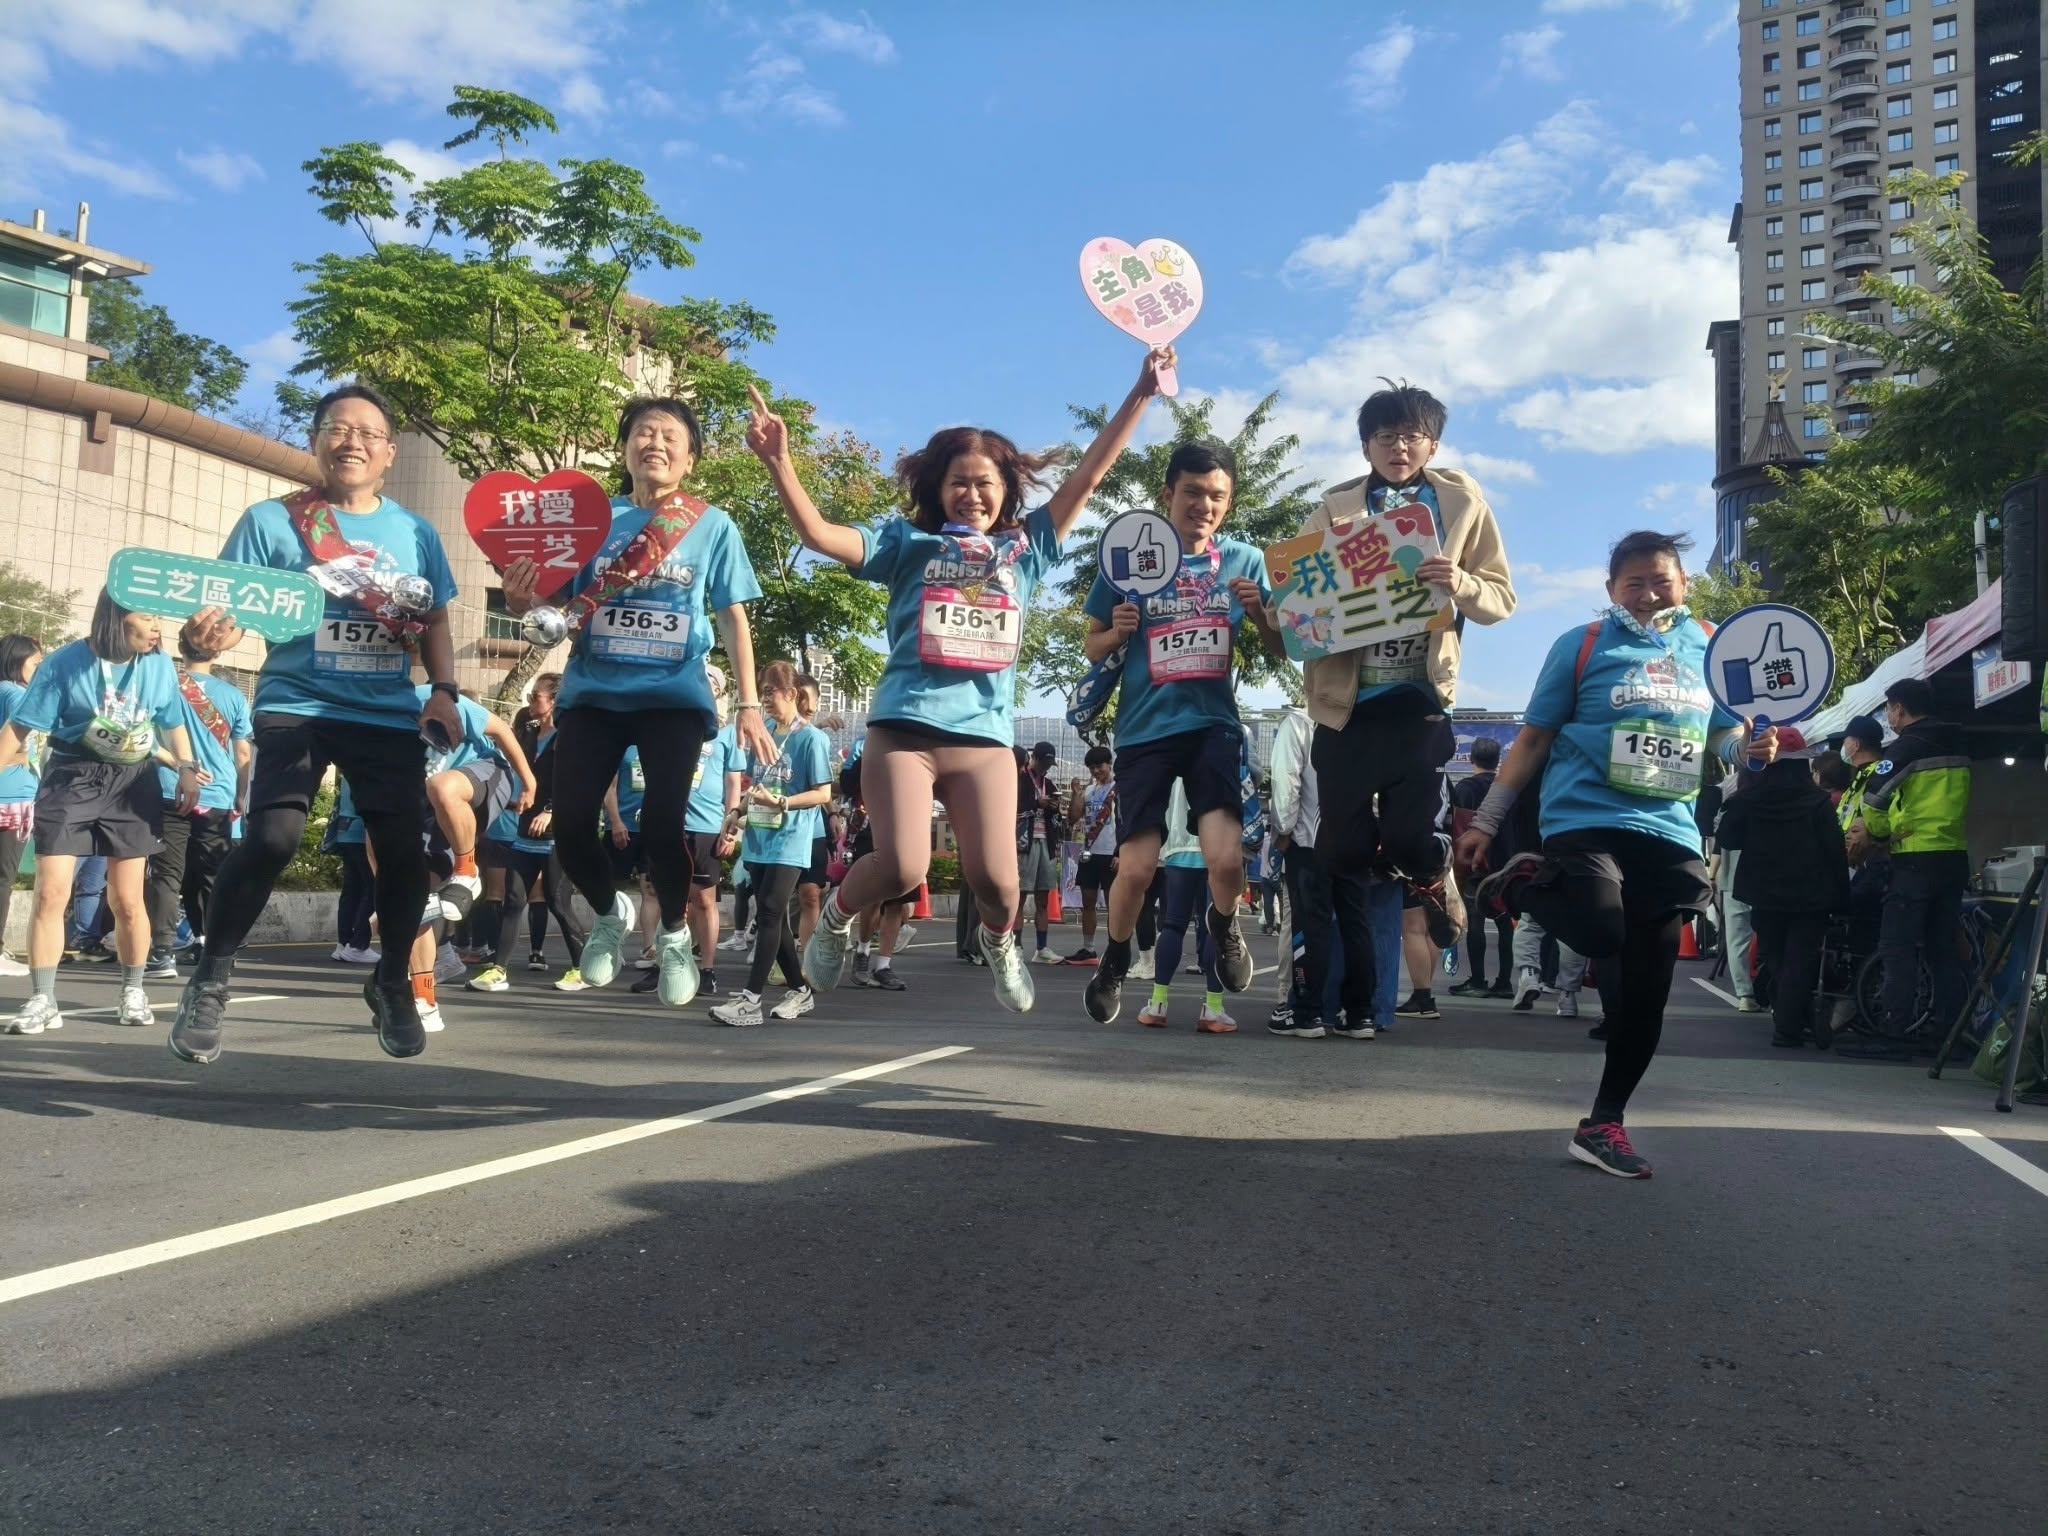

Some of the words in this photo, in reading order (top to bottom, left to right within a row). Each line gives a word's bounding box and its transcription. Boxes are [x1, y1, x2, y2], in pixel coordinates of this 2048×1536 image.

[1092, 256, 1153, 303] 主角
[1134, 281, 1195, 329] 是我
[499, 489, 574, 525] 我愛
[505, 534, 579, 568] 三芝
[1136, 548, 1158, 573] 讚
[1291, 522, 1398, 599] 我愛
[128, 566, 306, 622] 三芝區公所
[1338, 574, 1439, 635] 三芝
[604, 608, 679, 632] 156-3
[935, 604, 1007, 632] 156-1
[1159, 628, 1219, 652] 157-1
[1762, 658, 1796, 691] 讚
[96, 728, 149, 746] 03-2
[1625, 733, 1694, 763] 156-2
